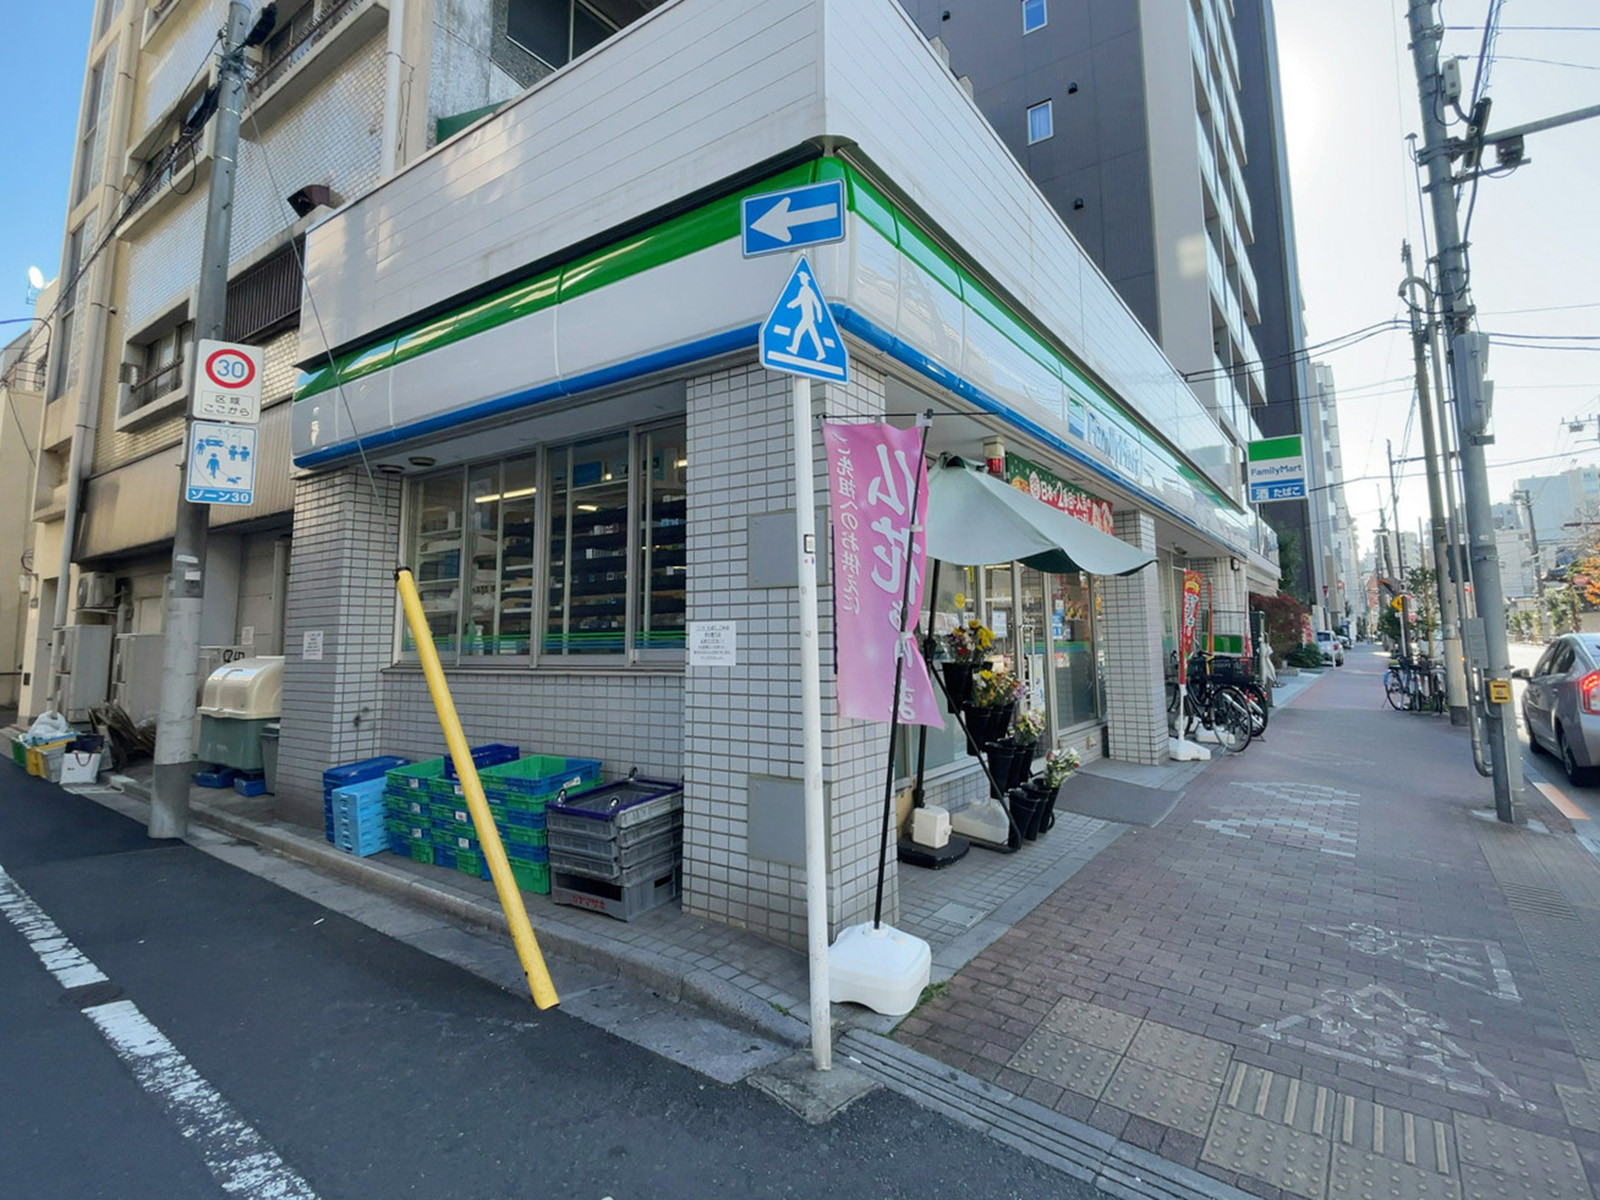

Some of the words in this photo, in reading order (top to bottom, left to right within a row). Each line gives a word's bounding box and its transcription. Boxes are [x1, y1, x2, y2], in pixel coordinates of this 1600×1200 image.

[217, 359, 245, 379] 30
[204, 403, 250, 416] ここから
[1251, 465, 1302, 476] FamilyMart
